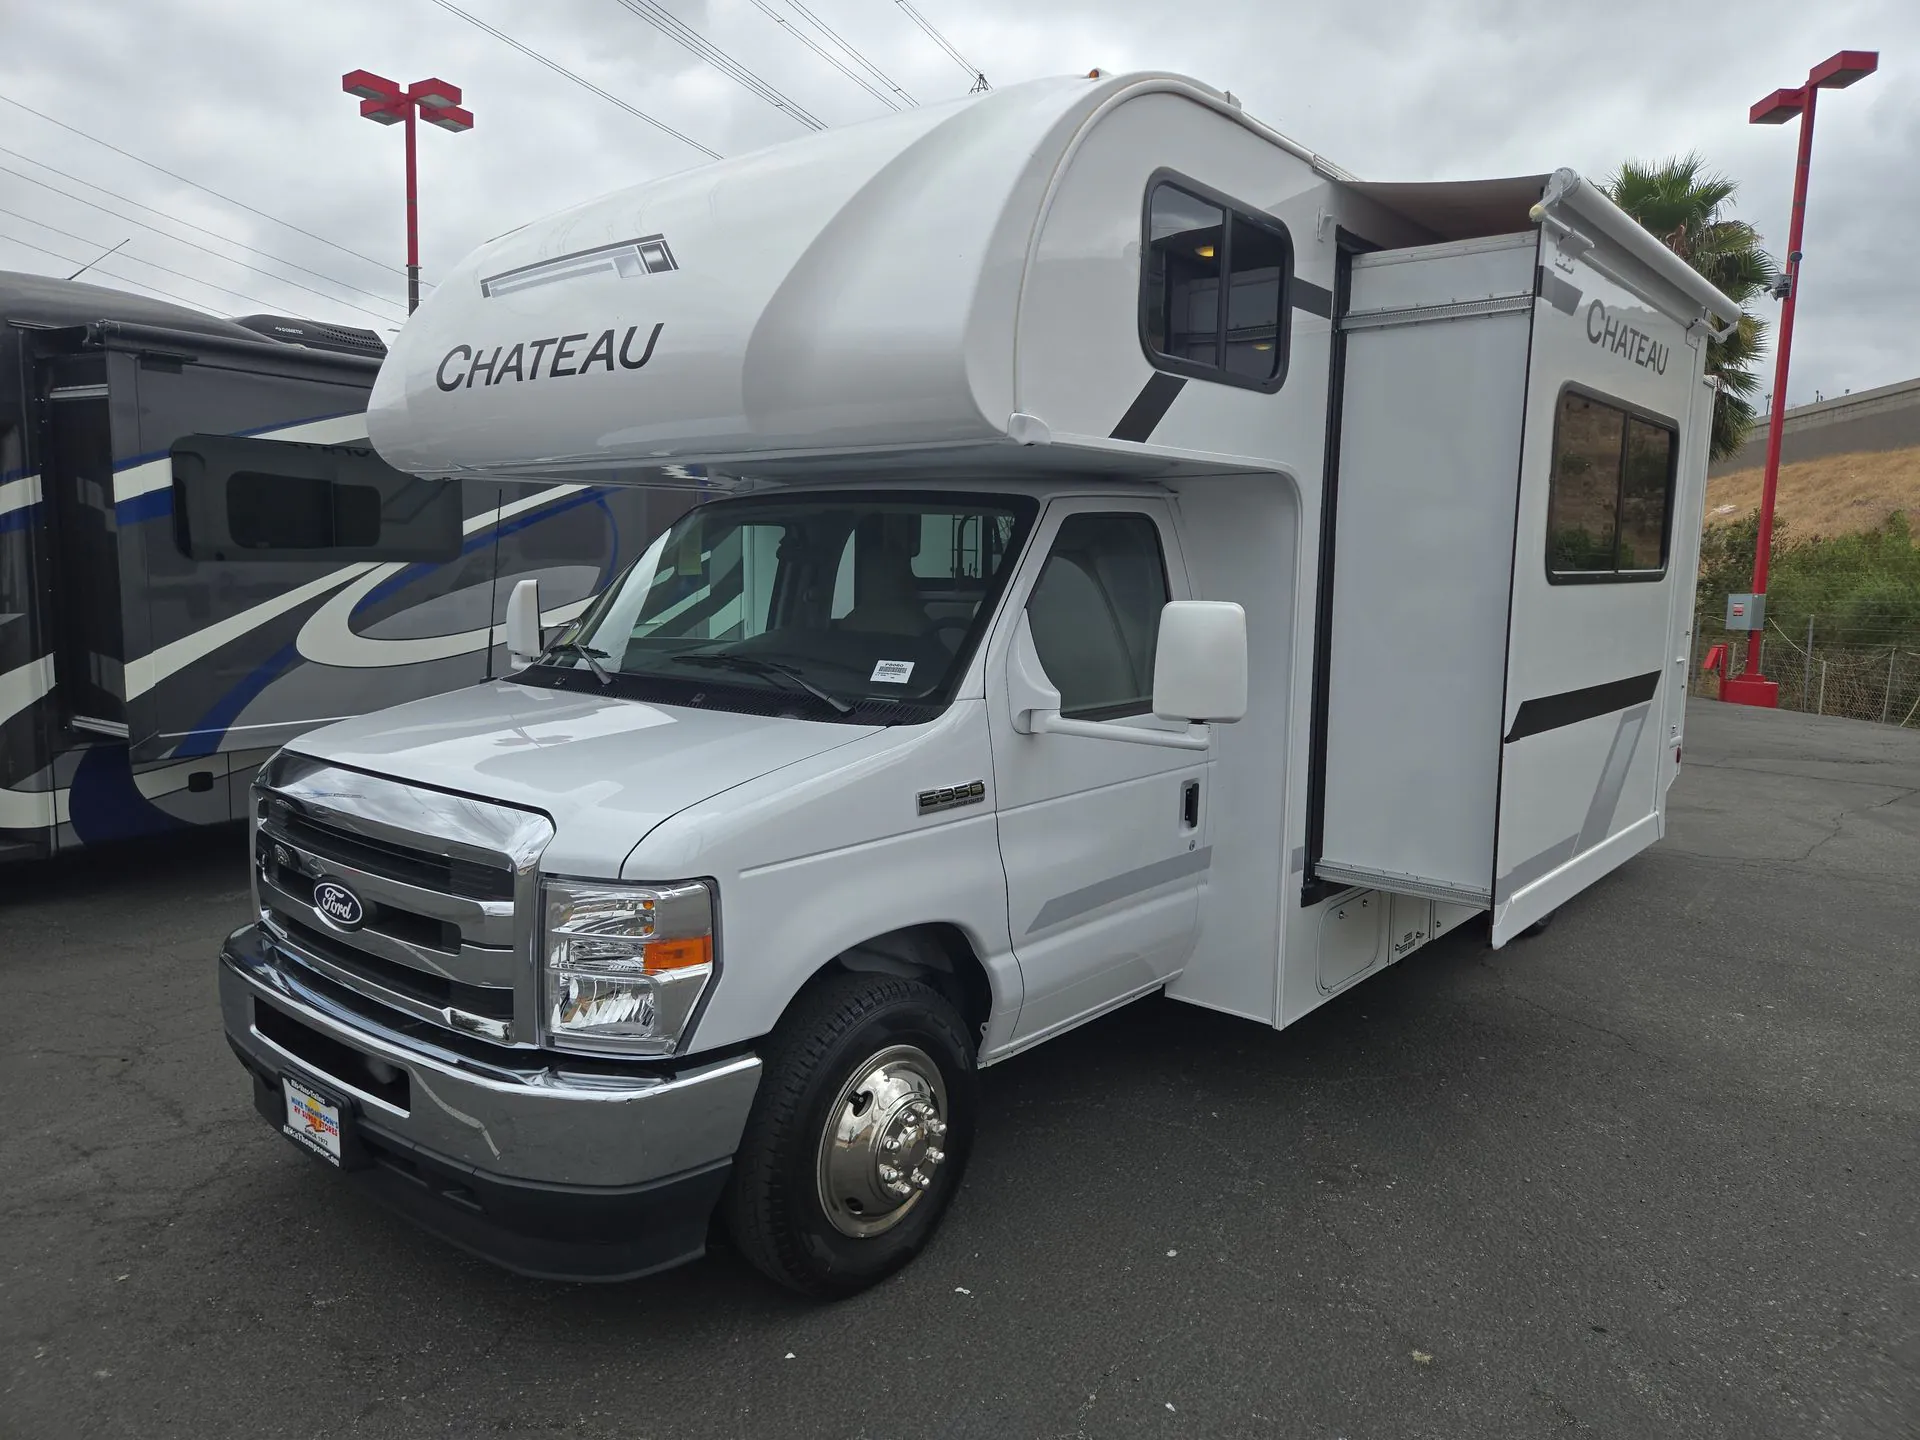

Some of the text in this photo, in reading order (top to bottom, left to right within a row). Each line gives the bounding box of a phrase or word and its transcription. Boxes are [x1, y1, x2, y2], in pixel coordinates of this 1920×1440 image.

[1586, 298, 1669, 376] CHATEAU
[435, 322, 665, 392] CHATEAU
[322, 887, 352, 919] Ford
[291, 1095, 304, 1109] MIKE
[293, 1105, 301, 1116] RV
[319, 1119, 338, 1137] STORES
